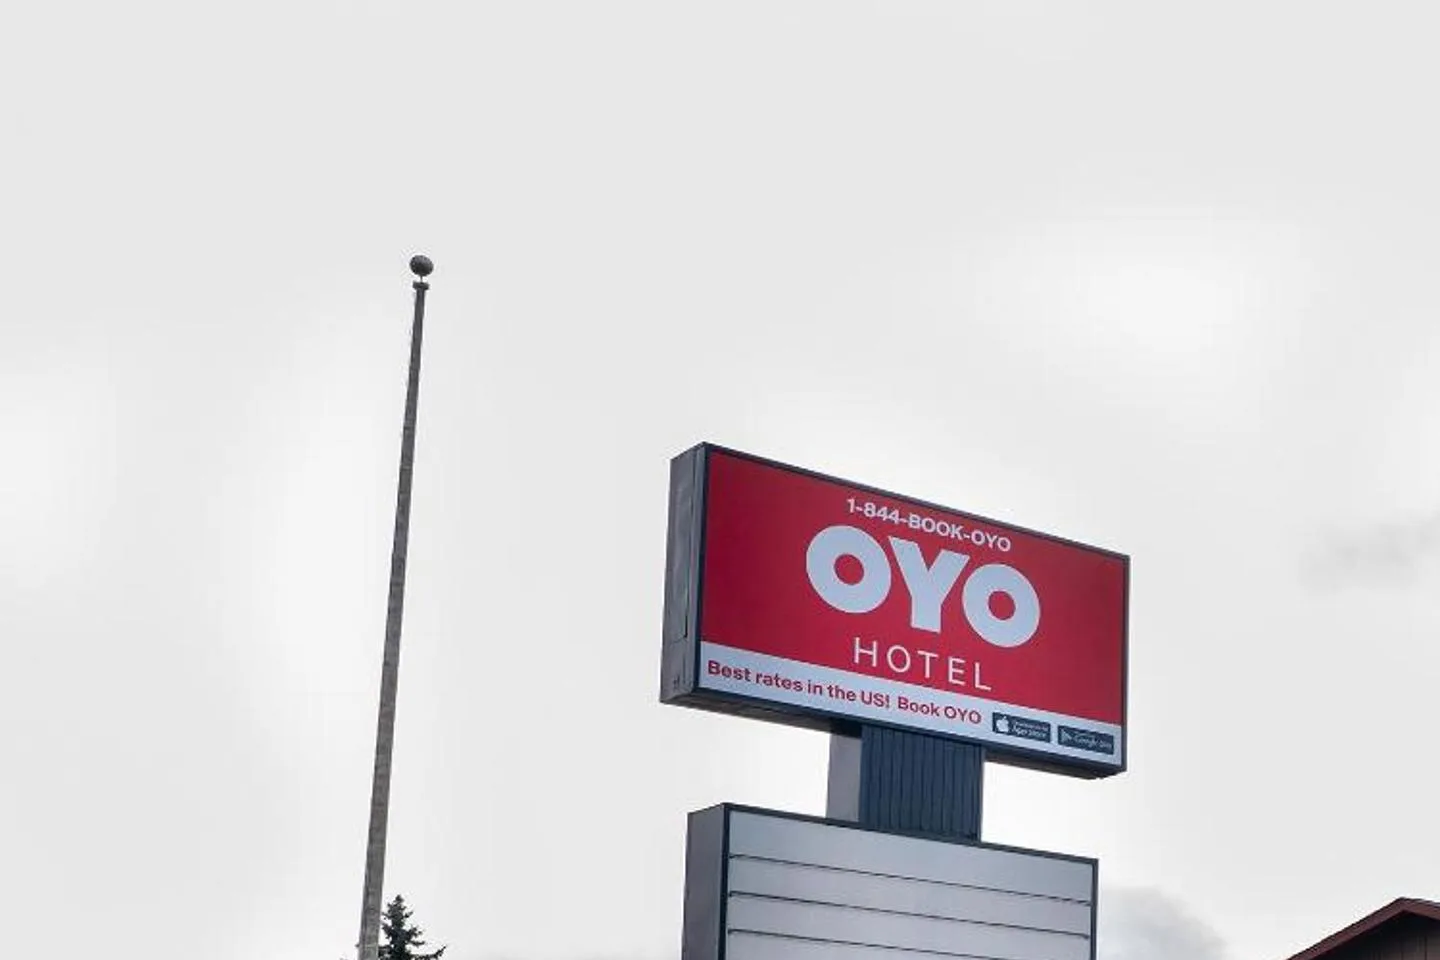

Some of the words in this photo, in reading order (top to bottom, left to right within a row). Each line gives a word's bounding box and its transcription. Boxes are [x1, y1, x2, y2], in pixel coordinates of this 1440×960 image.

[847, 498, 1012, 552] 1-844-BOOK-OYO
[805, 525, 1041, 648] OYO
[707, 660, 752, 682] Best
[755, 672, 803, 692] rates
[807, 679, 823, 696] in
[826, 684, 857, 702] the
[860, 690, 890, 709] US!
[897, 696, 940, 717] Book
[944, 705, 982, 724] OYO
[854, 636, 992, 691] HOTEL
